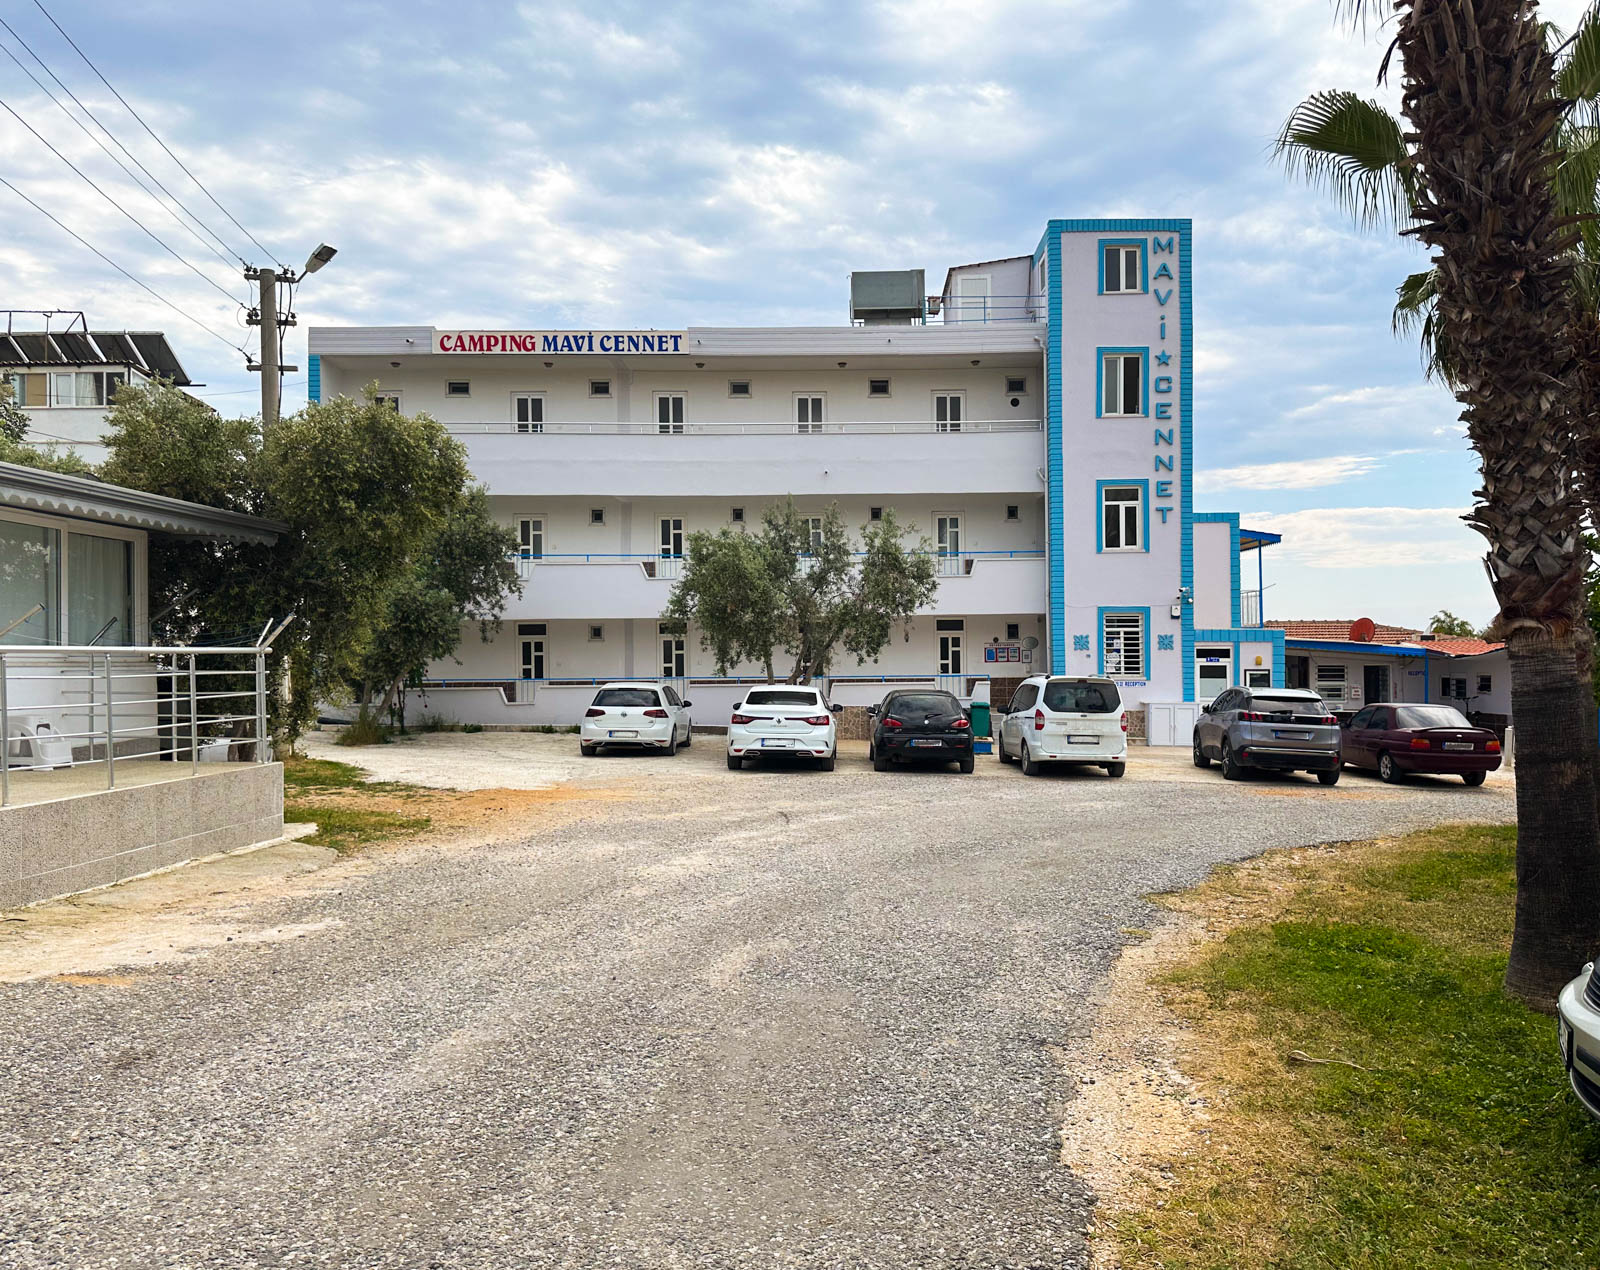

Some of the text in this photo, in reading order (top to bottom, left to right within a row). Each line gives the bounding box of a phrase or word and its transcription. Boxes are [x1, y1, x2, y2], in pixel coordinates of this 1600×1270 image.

[439, 331, 682, 352] CAMPING MAVİ CENNET
[1154, 375, 1174, 524] CENNET
